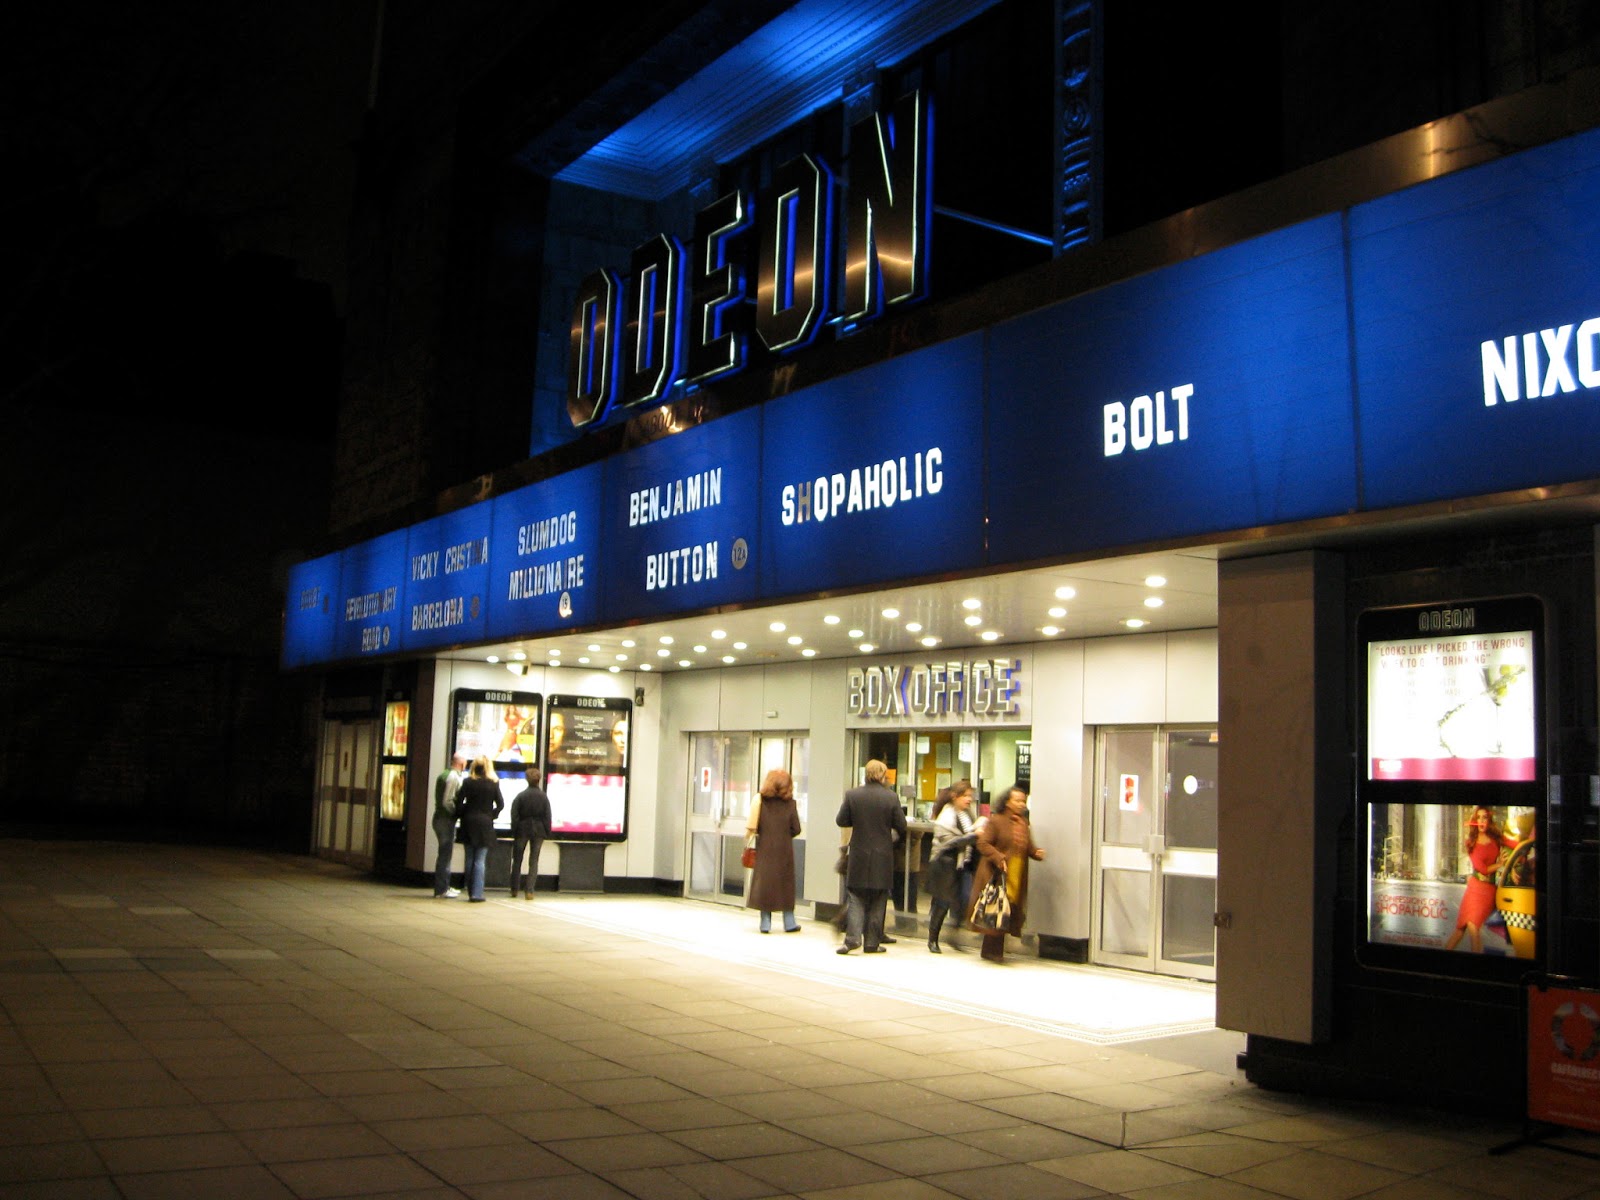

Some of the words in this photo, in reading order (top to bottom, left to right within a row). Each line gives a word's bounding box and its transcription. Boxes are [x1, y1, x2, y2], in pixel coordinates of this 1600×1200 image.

[566, 87, 932, 429] ODEON
[1104, 383, 1194, 457] BOLT
[629, 467, 722, 527] BENJAMIN
[782, 447, 943, 525] SHOPAHOLIC
[517, 510, 577, 556] SLUMDOG
[412, 551, 439, 581] VICKY
[508, 554, 584, 600] MILLIONAIRE
[646, 541, 718, 590] BUTTON
[412, 597, 464, 631] BARCELONA
[1418, 608, 1475, 631] ODEON
[1409, 643, 1427, 655] LIKE
[1471, 639, 1488, 651] THE
[1491, 637, 1525, 650] WRONG
[485, 691, 513, 703] ODEON
[848, 664, 906, 717] BOX
[912, 657, 1018, 716] OFFICE
[1376, 902, 1448, 920] SHOPAHOLIC
